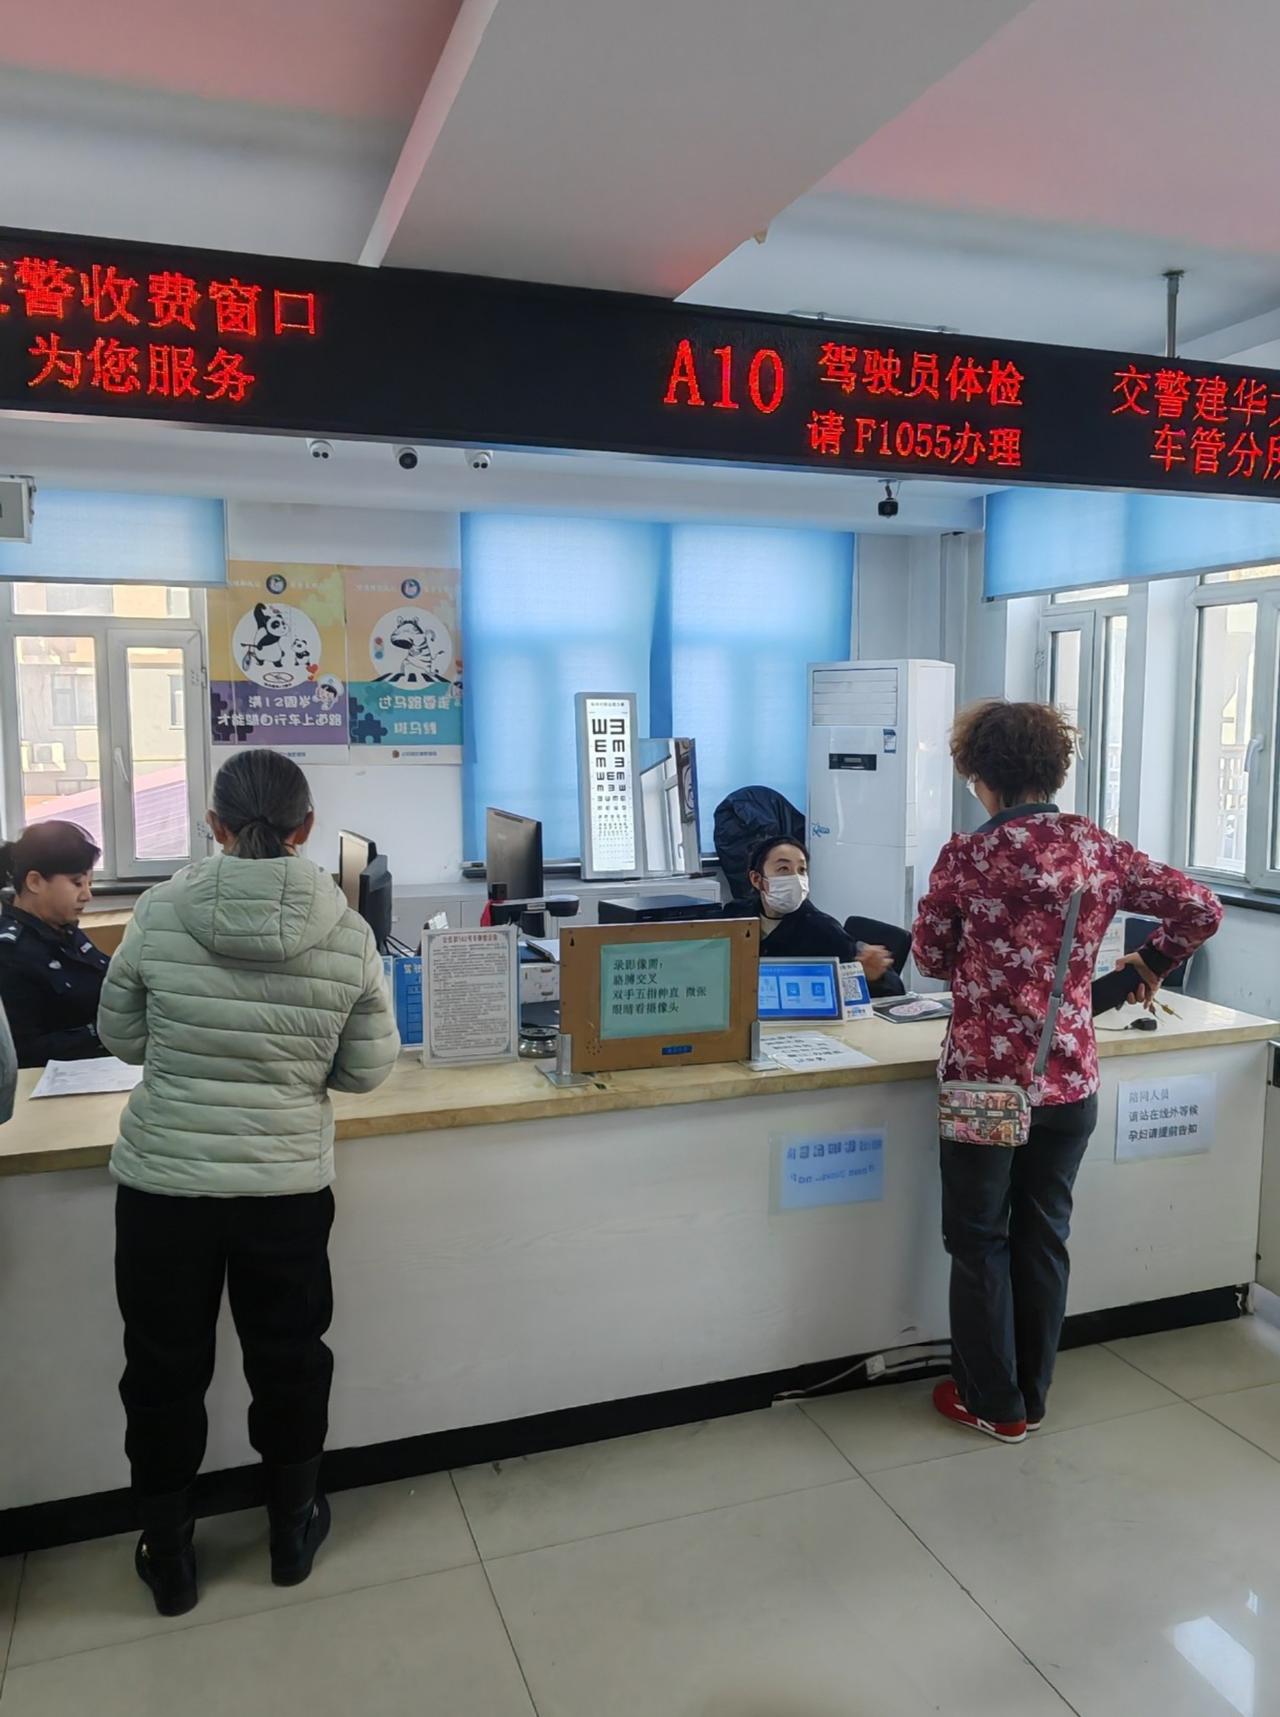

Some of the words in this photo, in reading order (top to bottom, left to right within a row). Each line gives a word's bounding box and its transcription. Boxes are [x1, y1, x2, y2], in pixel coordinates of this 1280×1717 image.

[0, 256, 316, 337] 警收费窗口
[28, 332, 256, 402] 为您服务
[663, 338, 785, 414] A10
[818, 341, 1025, 407] 驾驶员体检
[1128, 1104, 1199, 1122] 请站在线外等候
